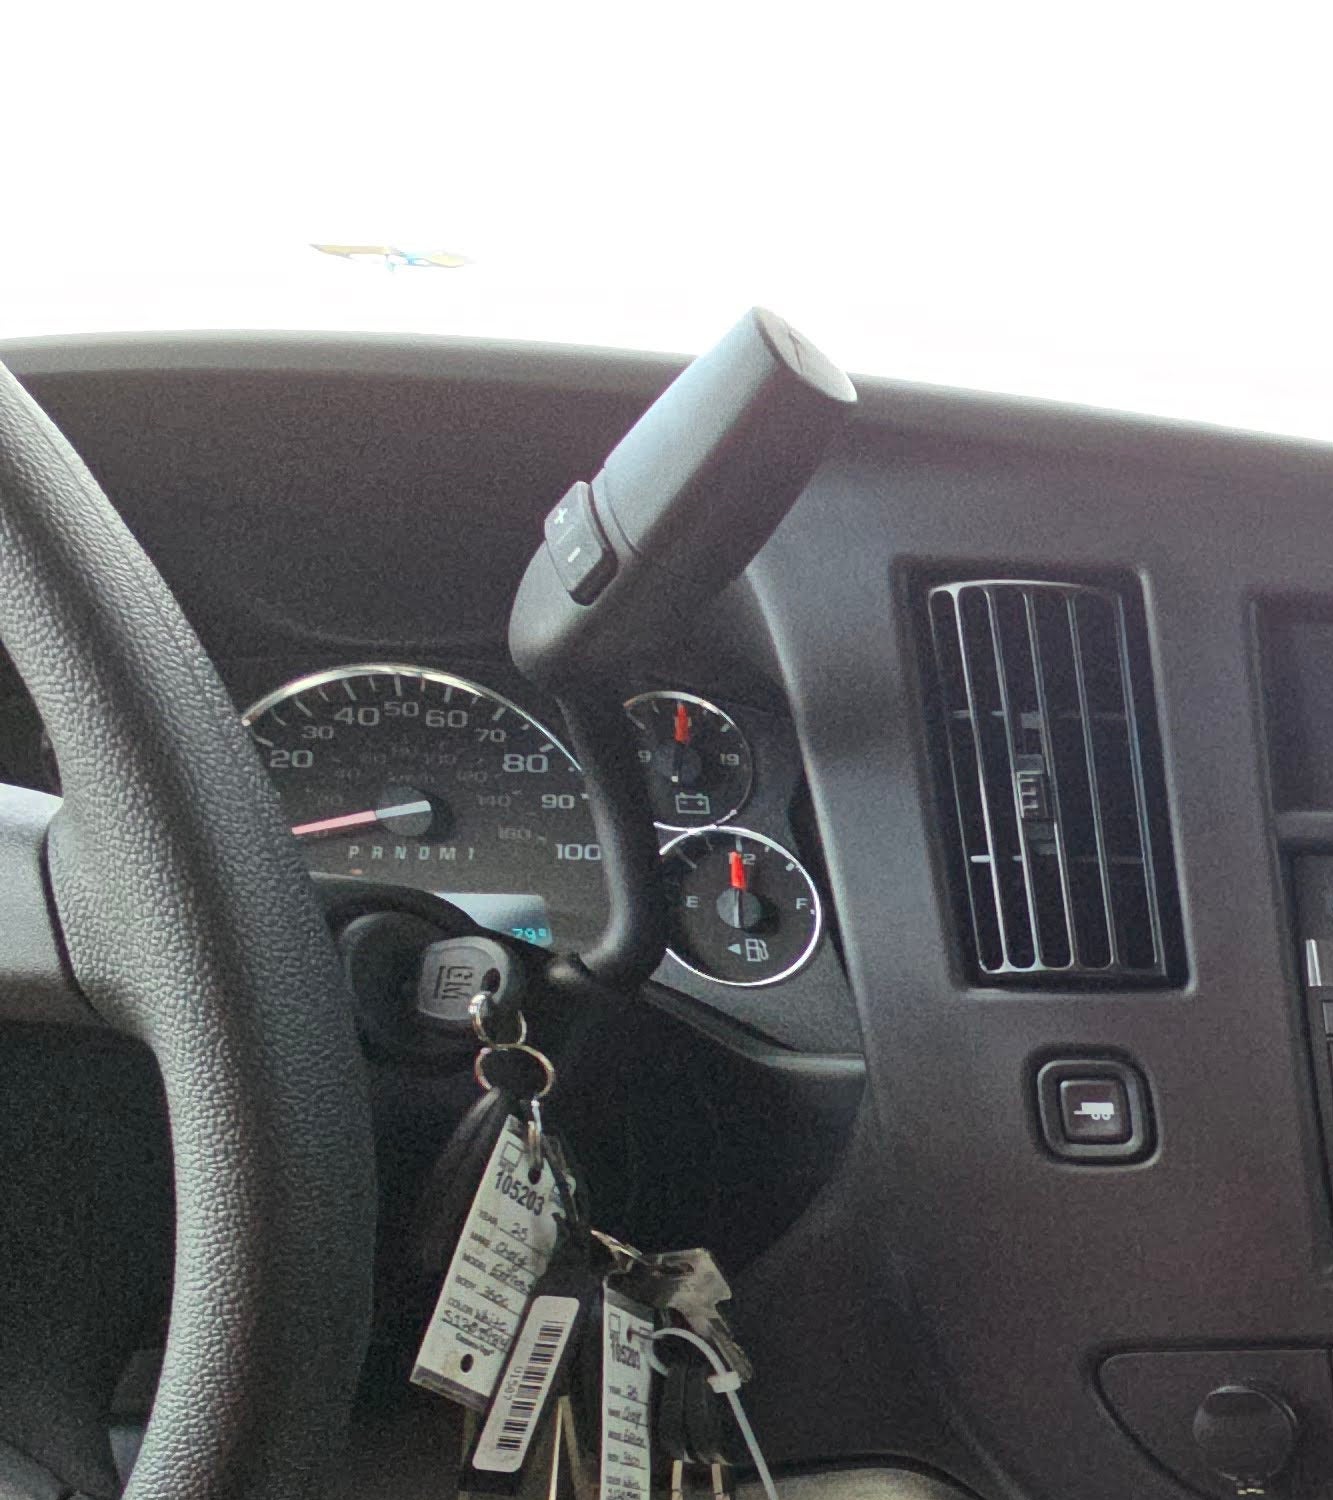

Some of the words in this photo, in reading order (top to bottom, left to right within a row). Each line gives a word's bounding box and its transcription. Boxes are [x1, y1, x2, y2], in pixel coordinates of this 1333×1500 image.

[334, 707, 380, 727] 40
[384, 701, 419, 717] 50
[425, 709, 468, 728] 60
[301, 725, 335, 740] 30
[474, 728, 507, 743] 70
[269, 749, 314, 769] 20
[502, 753, 549, 773] 80
[637, 750, 651, 763] 9
[720, 752, 740, 766] 19
[541, 793, 575, 809] 90
[349, 845, 360, 859] P
[394, 845, 407, 859] N
[439, 847, 457, 860] M
[554, 843, 602, 861] 100
[685, 895, 699, 908] E
[795, 897, 808, 910] F
[495, 1170, 545, 1216] 105203
